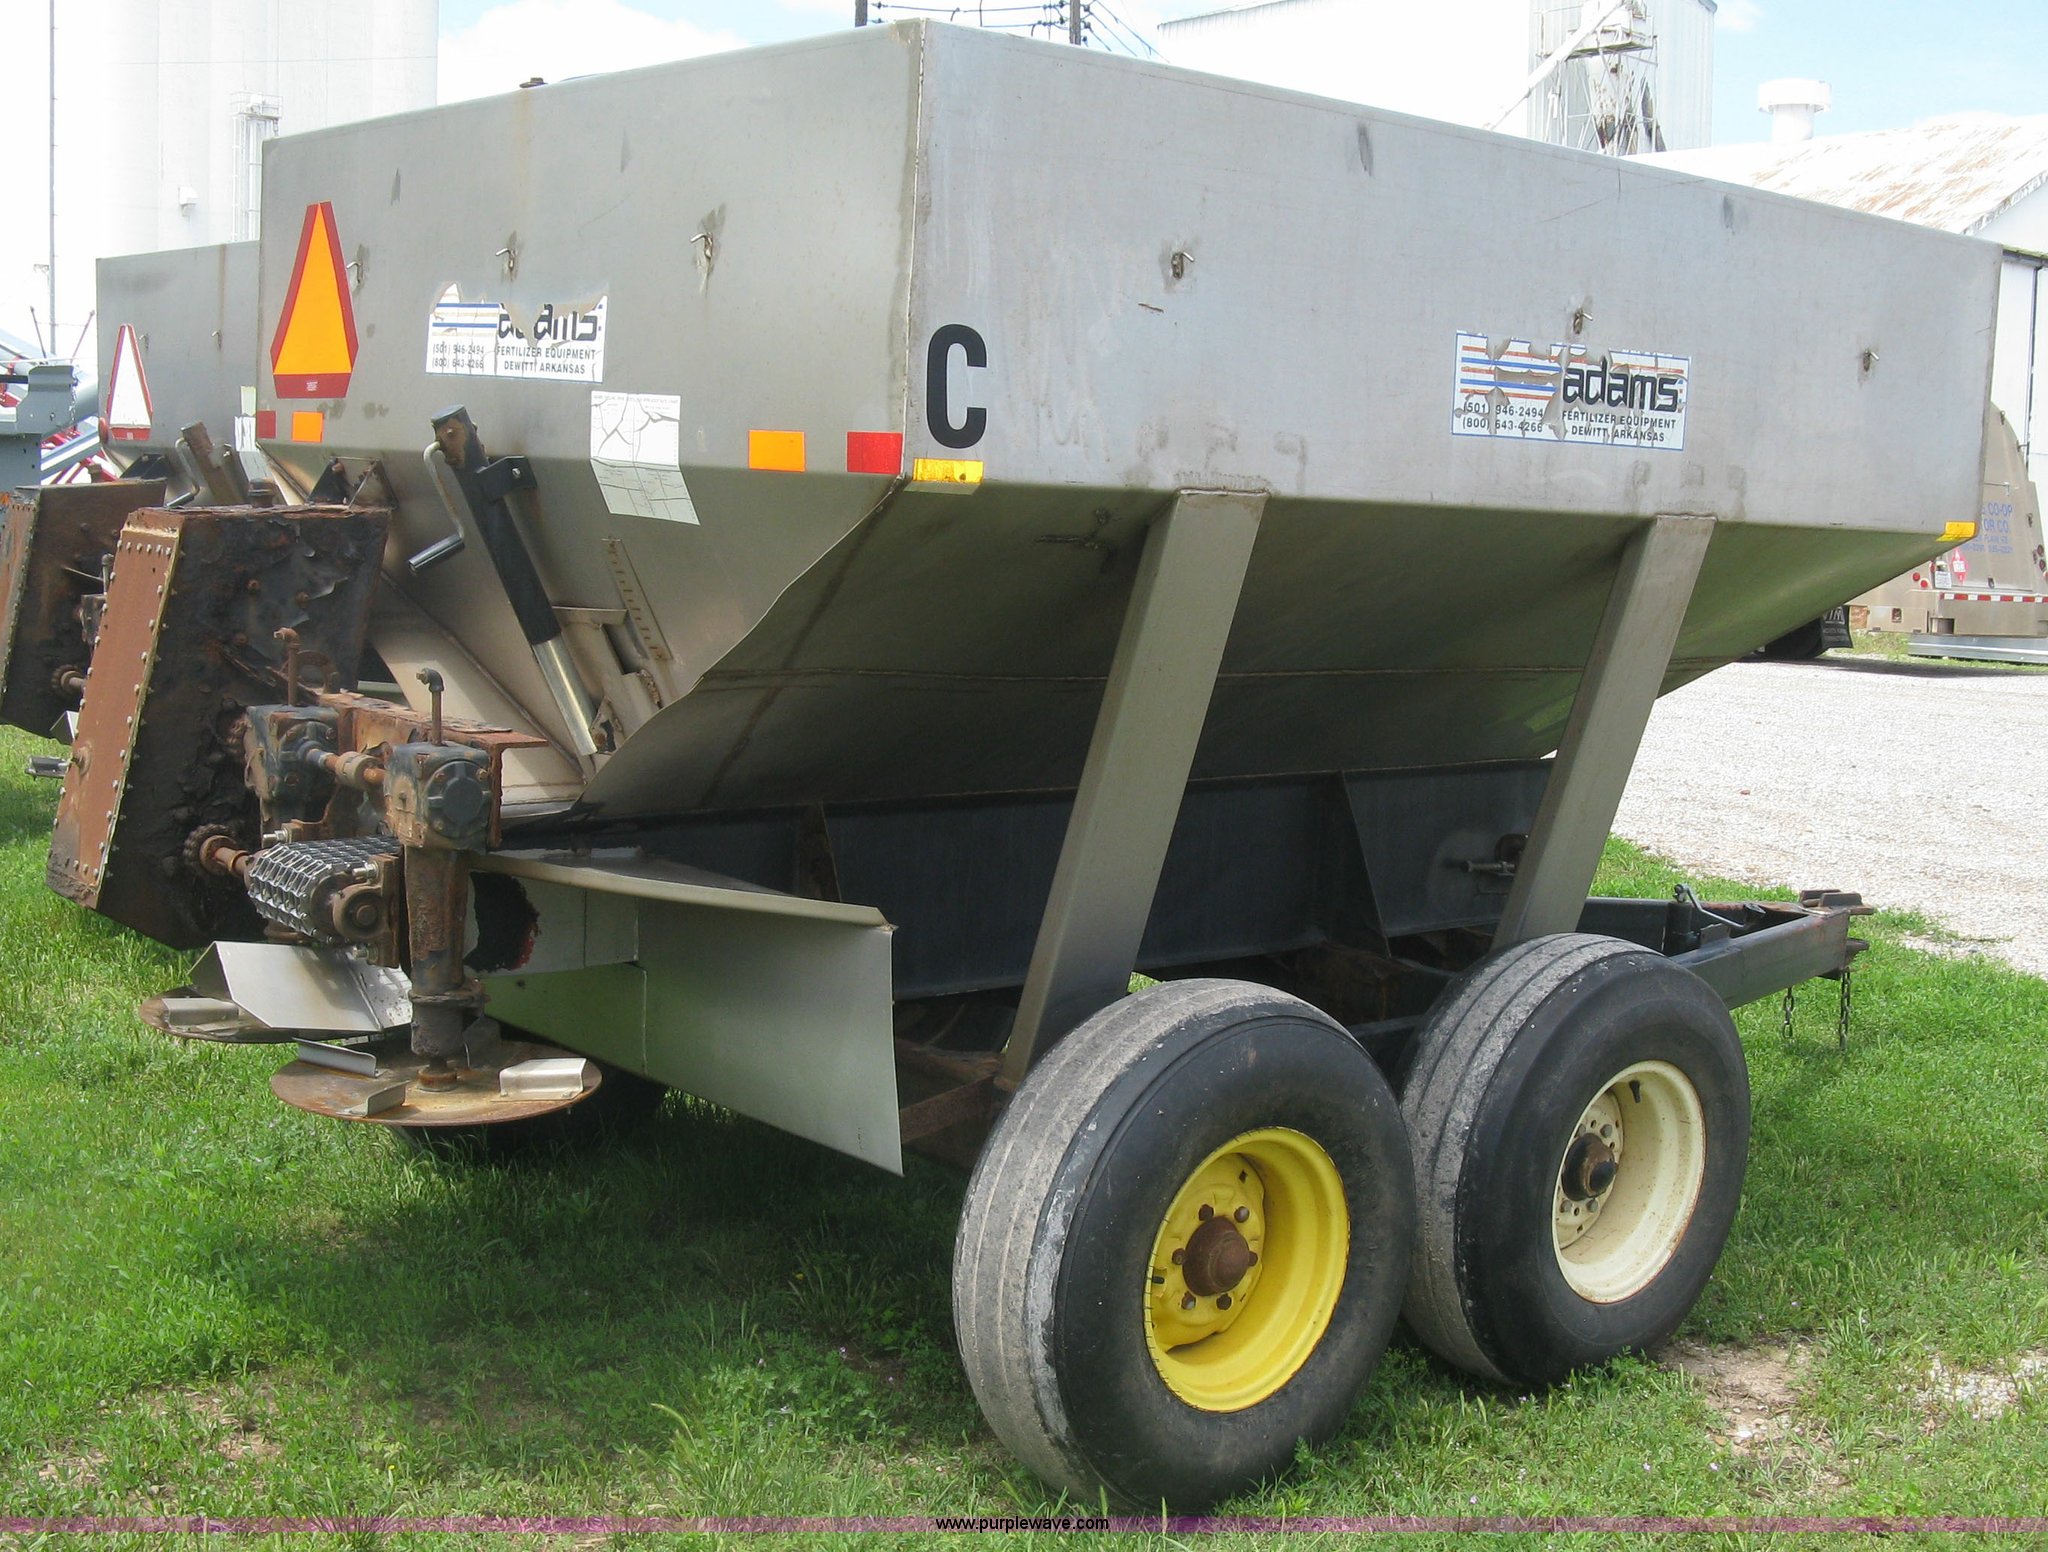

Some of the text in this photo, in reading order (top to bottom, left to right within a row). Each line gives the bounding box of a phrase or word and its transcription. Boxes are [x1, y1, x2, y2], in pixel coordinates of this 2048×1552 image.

[496, 345, 596, 360] FERTILIZER EQUIPMENT
[540, 362, 586, 374] ARKANSAS
[926, 323, 987, 449] C
[1562, 356, 1679, 413] adams
[1463, 400, 1490, 415] (501)
[1462, 416, 1490, 431] (800)
[1562, 410, 1677, 429] FERTILIZER EQUIPMENT
[1614, 429, 1665, 442] ARKANSAS
